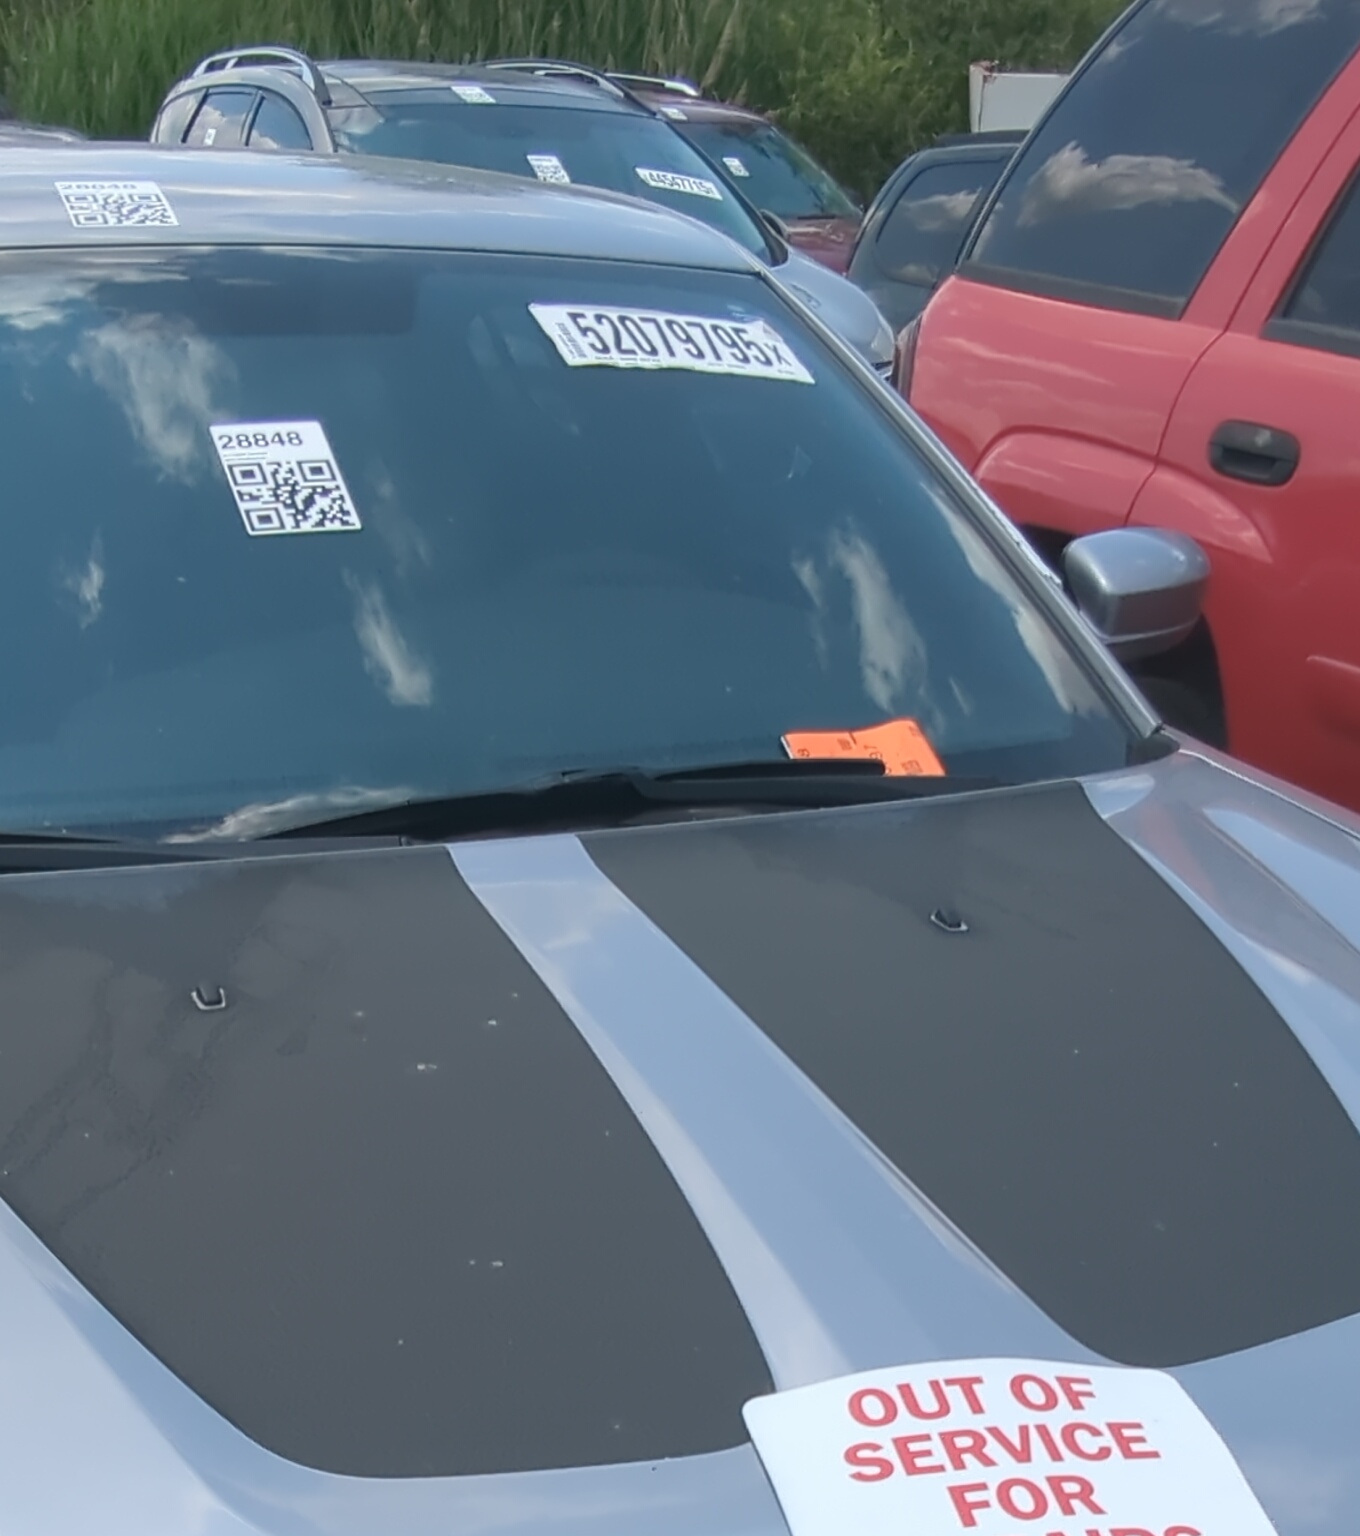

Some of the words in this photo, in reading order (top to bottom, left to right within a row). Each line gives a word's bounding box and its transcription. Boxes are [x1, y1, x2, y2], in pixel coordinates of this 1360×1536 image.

[218, 431, 303, 449] 28848
[846, 1375, 986, 1428] OUT
[1009, 1372, 1097, 1414] OF
[842, 1421, 1162, 1483] SERVICE
[946, 1474, 1107, 1528] FOR
